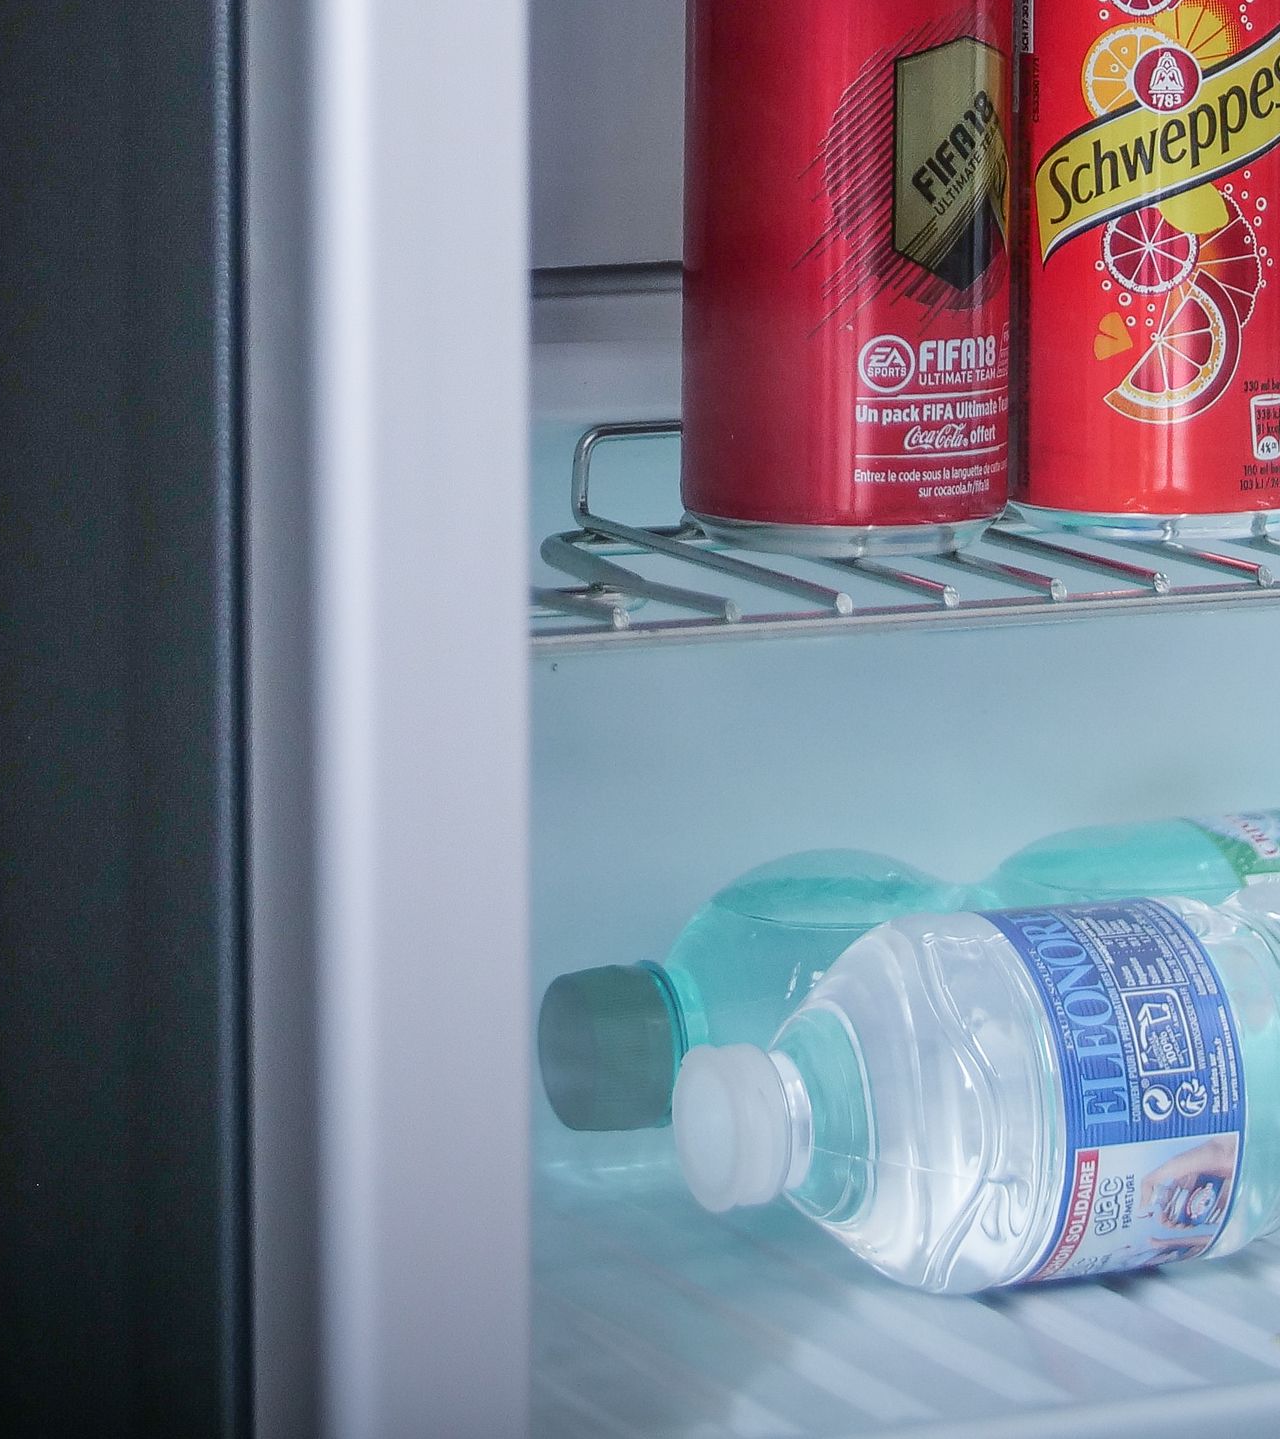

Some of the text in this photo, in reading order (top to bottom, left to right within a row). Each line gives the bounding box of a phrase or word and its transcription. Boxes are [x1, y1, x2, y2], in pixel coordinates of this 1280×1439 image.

[1150, 92, 1182, 109] 1783
[933, 151, 982, 216] ULTIMATE
[868, 346, 907, 367] EA
[919, 335, 996, 373] FIFA18
[867, 366, 907, 377] SPORTS
[919, 371, 973, 386] ULTIMATE
[855, 404, 878, 423] Un
[882, 404, 920, 426] pack
[923, 403, 954, 421] FIFA
[956, 399, 997, 419] Ultimate
[903, 422, 996, 450] Coca-Cola offert
[854, 469, 885, 483] Entrez
[888, 469, 897, 482] le
[899, 468, 920, 482] code
[922, 469, 942, 480] sous
[943, 467, 950, 480] la
[952, 464, 983, 480] languette
[918, 486, 932, 498] sur
[1027, 948, 1073, 1051] EAU DE SOURCE
[1124, 1042, 1134, 1054] LA
[1158, 1030, 1178, 1065] 100%
[1126, 1055, 1138, 1079] POUR
[1129, 1081, 1142, 1124] CONVIENT
[1065, 1160, 1096, 1242] SOLIDAIRE
[1121, 1173, 1135, 1229] FERMETURE
